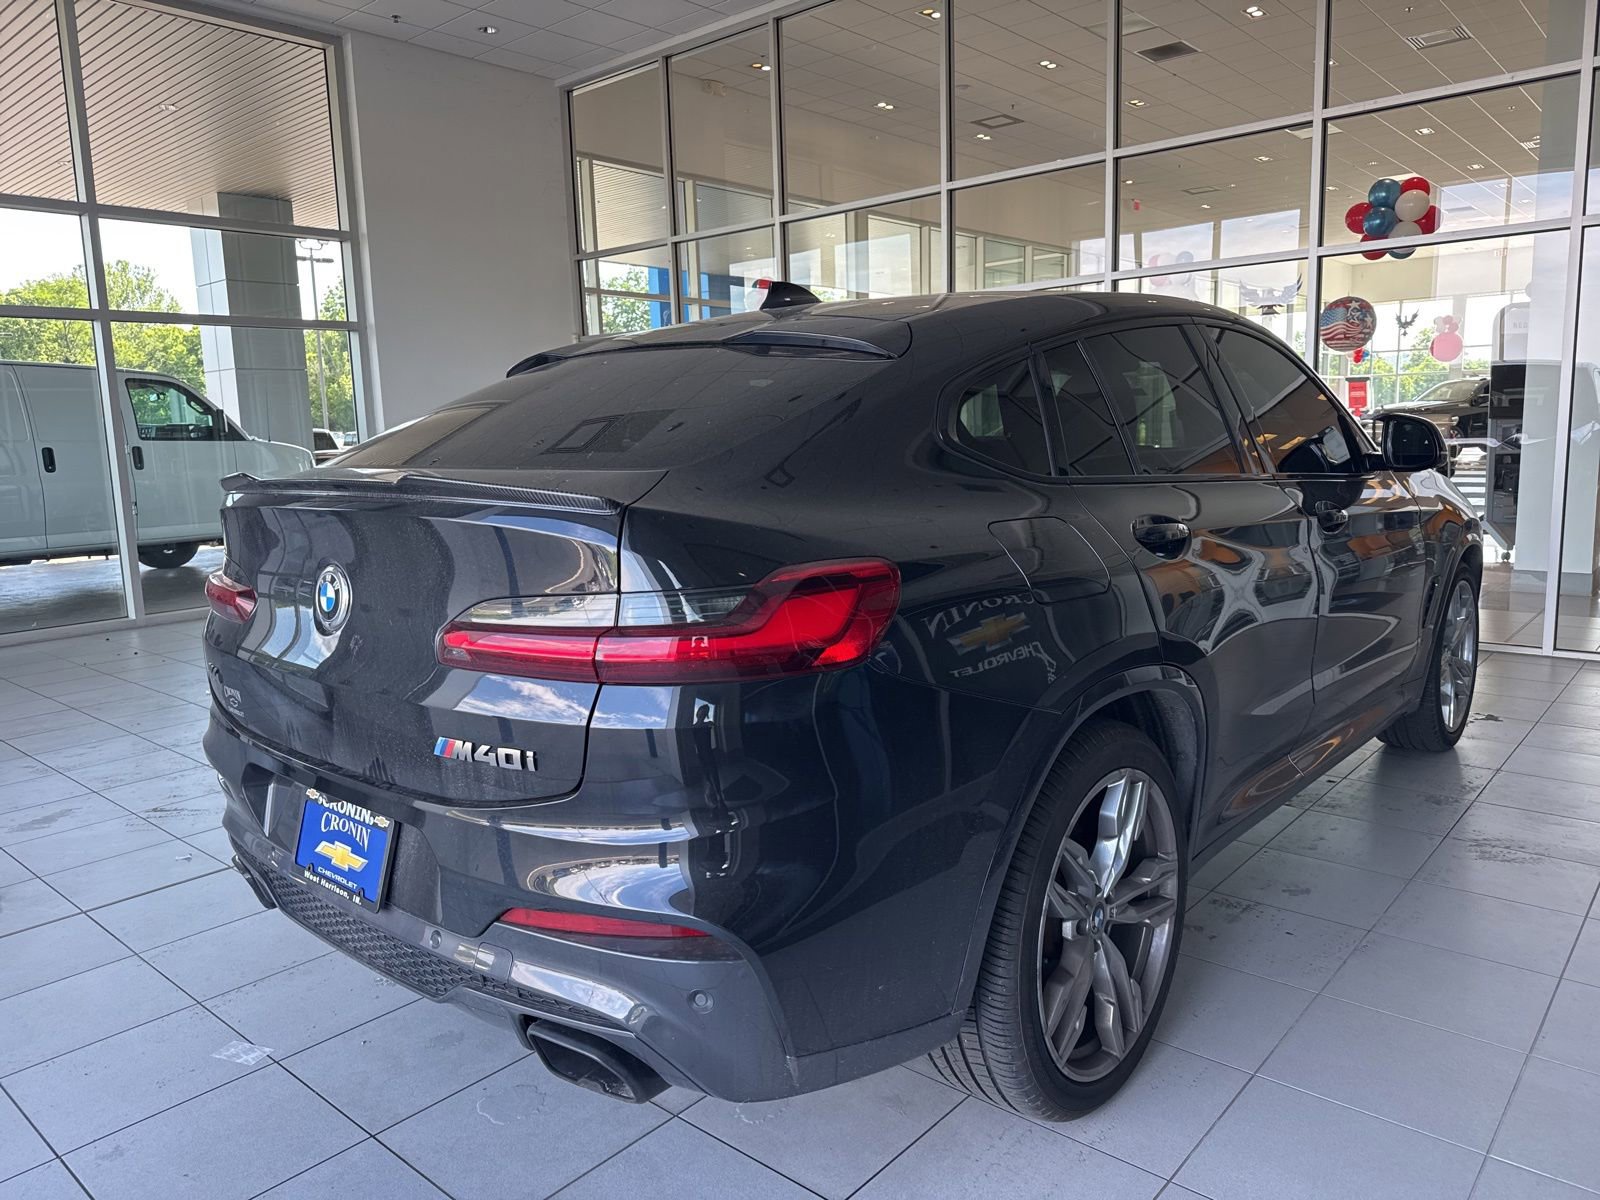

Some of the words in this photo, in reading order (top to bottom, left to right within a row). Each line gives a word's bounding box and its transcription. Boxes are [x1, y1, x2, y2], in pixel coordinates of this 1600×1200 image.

[451, 740, 536, 772] M40i
[320, 811, 371, 852] CRONIN
[304, 870, 319, 883] West
[317, 866, 358, 889] CHEVROLET
